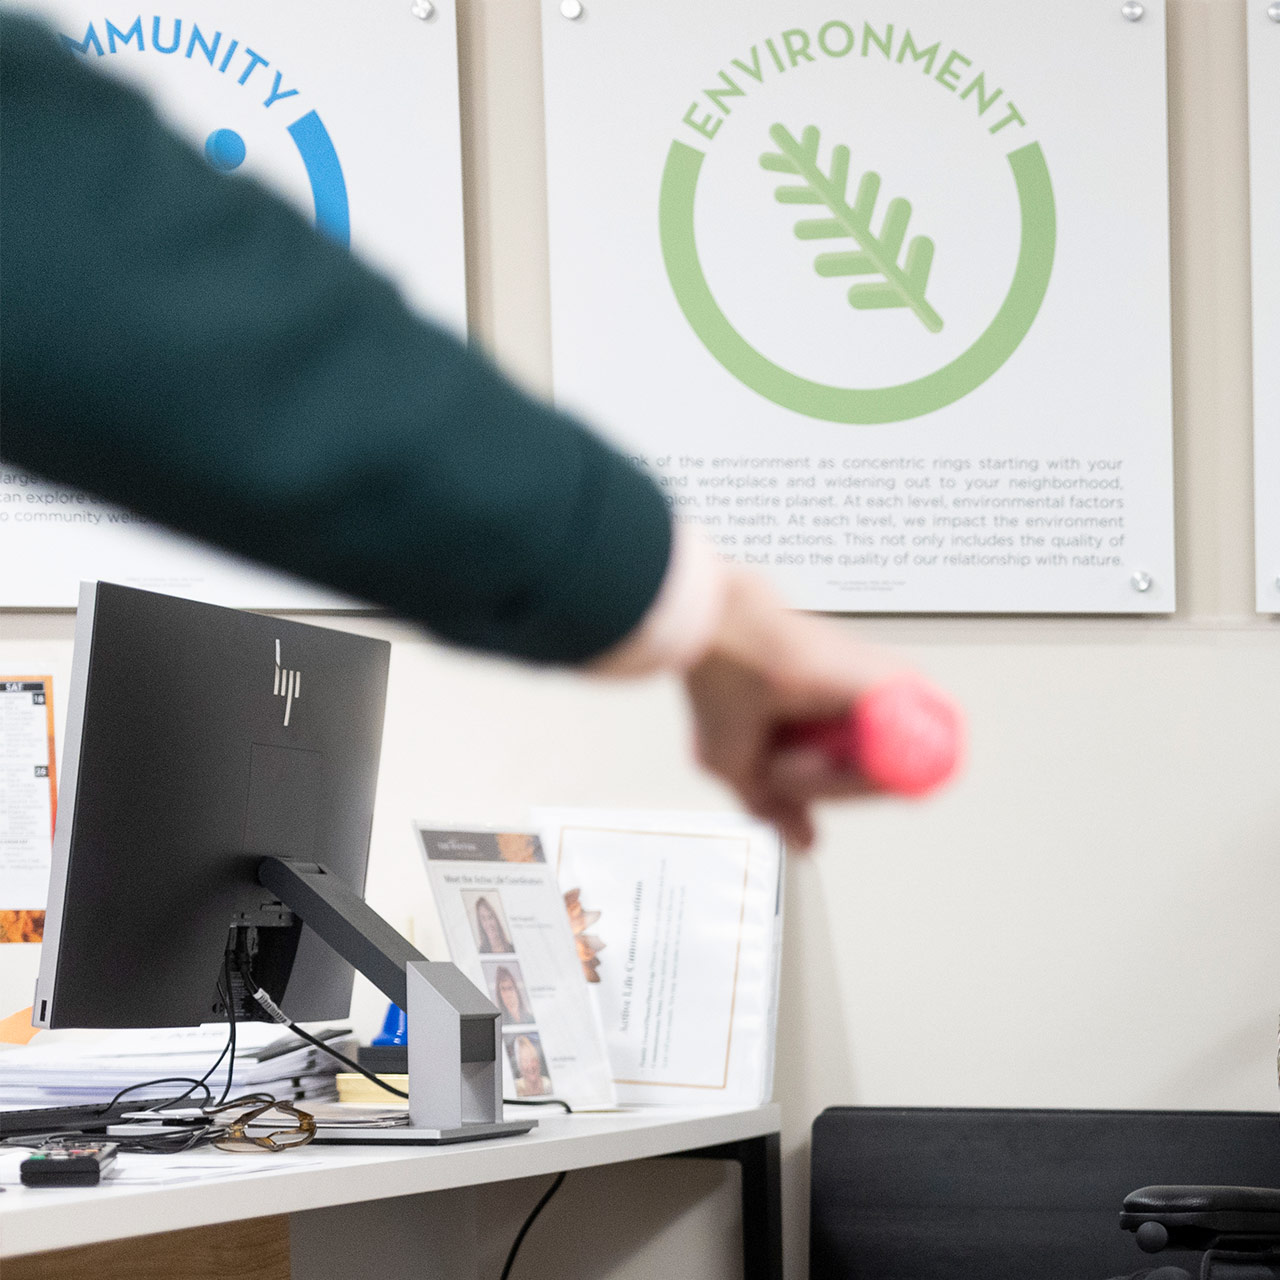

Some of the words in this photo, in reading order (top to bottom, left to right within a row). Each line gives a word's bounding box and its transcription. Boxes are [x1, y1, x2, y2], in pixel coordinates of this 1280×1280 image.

[58, 15, 300, 109] MMUNITY
[683, 21, 1026, 140] ENVIRONMENT
[14, 510, 101, 525] community
[274, 639, 300, 726] hp
